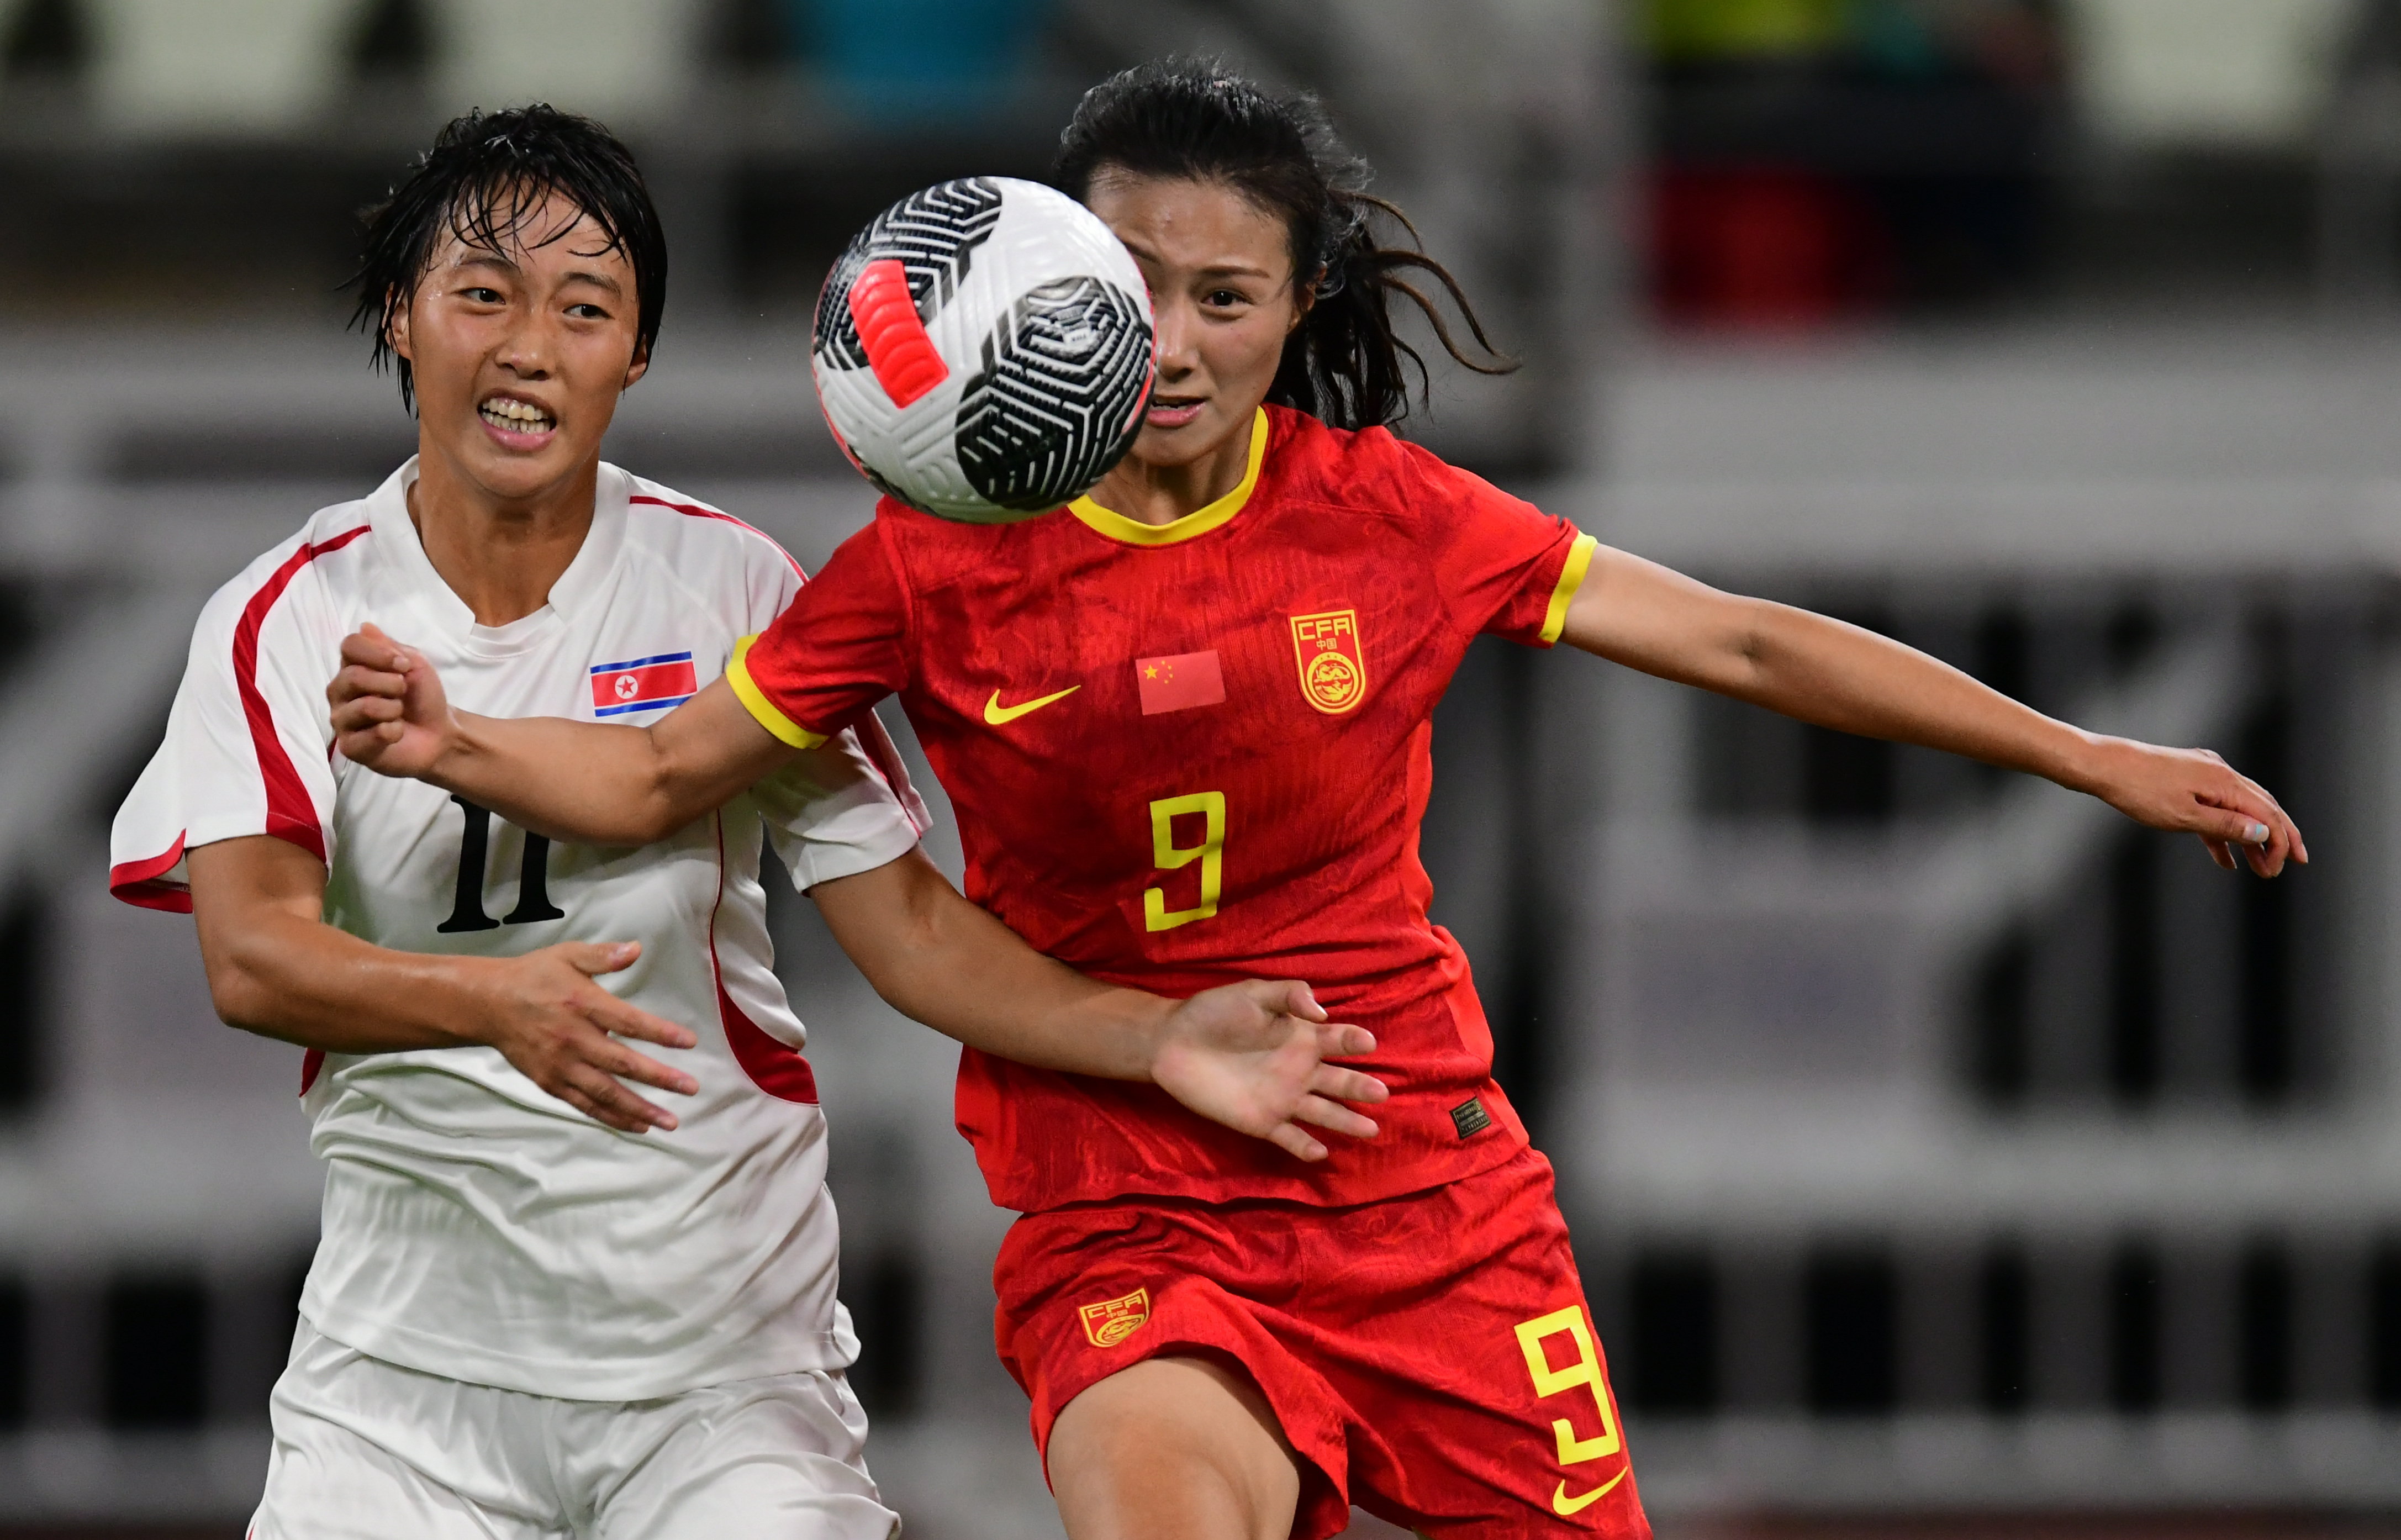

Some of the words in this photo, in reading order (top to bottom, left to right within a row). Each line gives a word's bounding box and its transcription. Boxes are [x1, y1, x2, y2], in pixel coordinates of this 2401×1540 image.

[1298, 618, 1350, 640] CFA
[1316, 638, 1337, 651] 中国
[437, 794, 565, 933] 11
[1144, 791, 1225, 932] 9
[1087, 1295, 1142, 1319] CFA
[1514, 1305, 1620, 1465] 9
